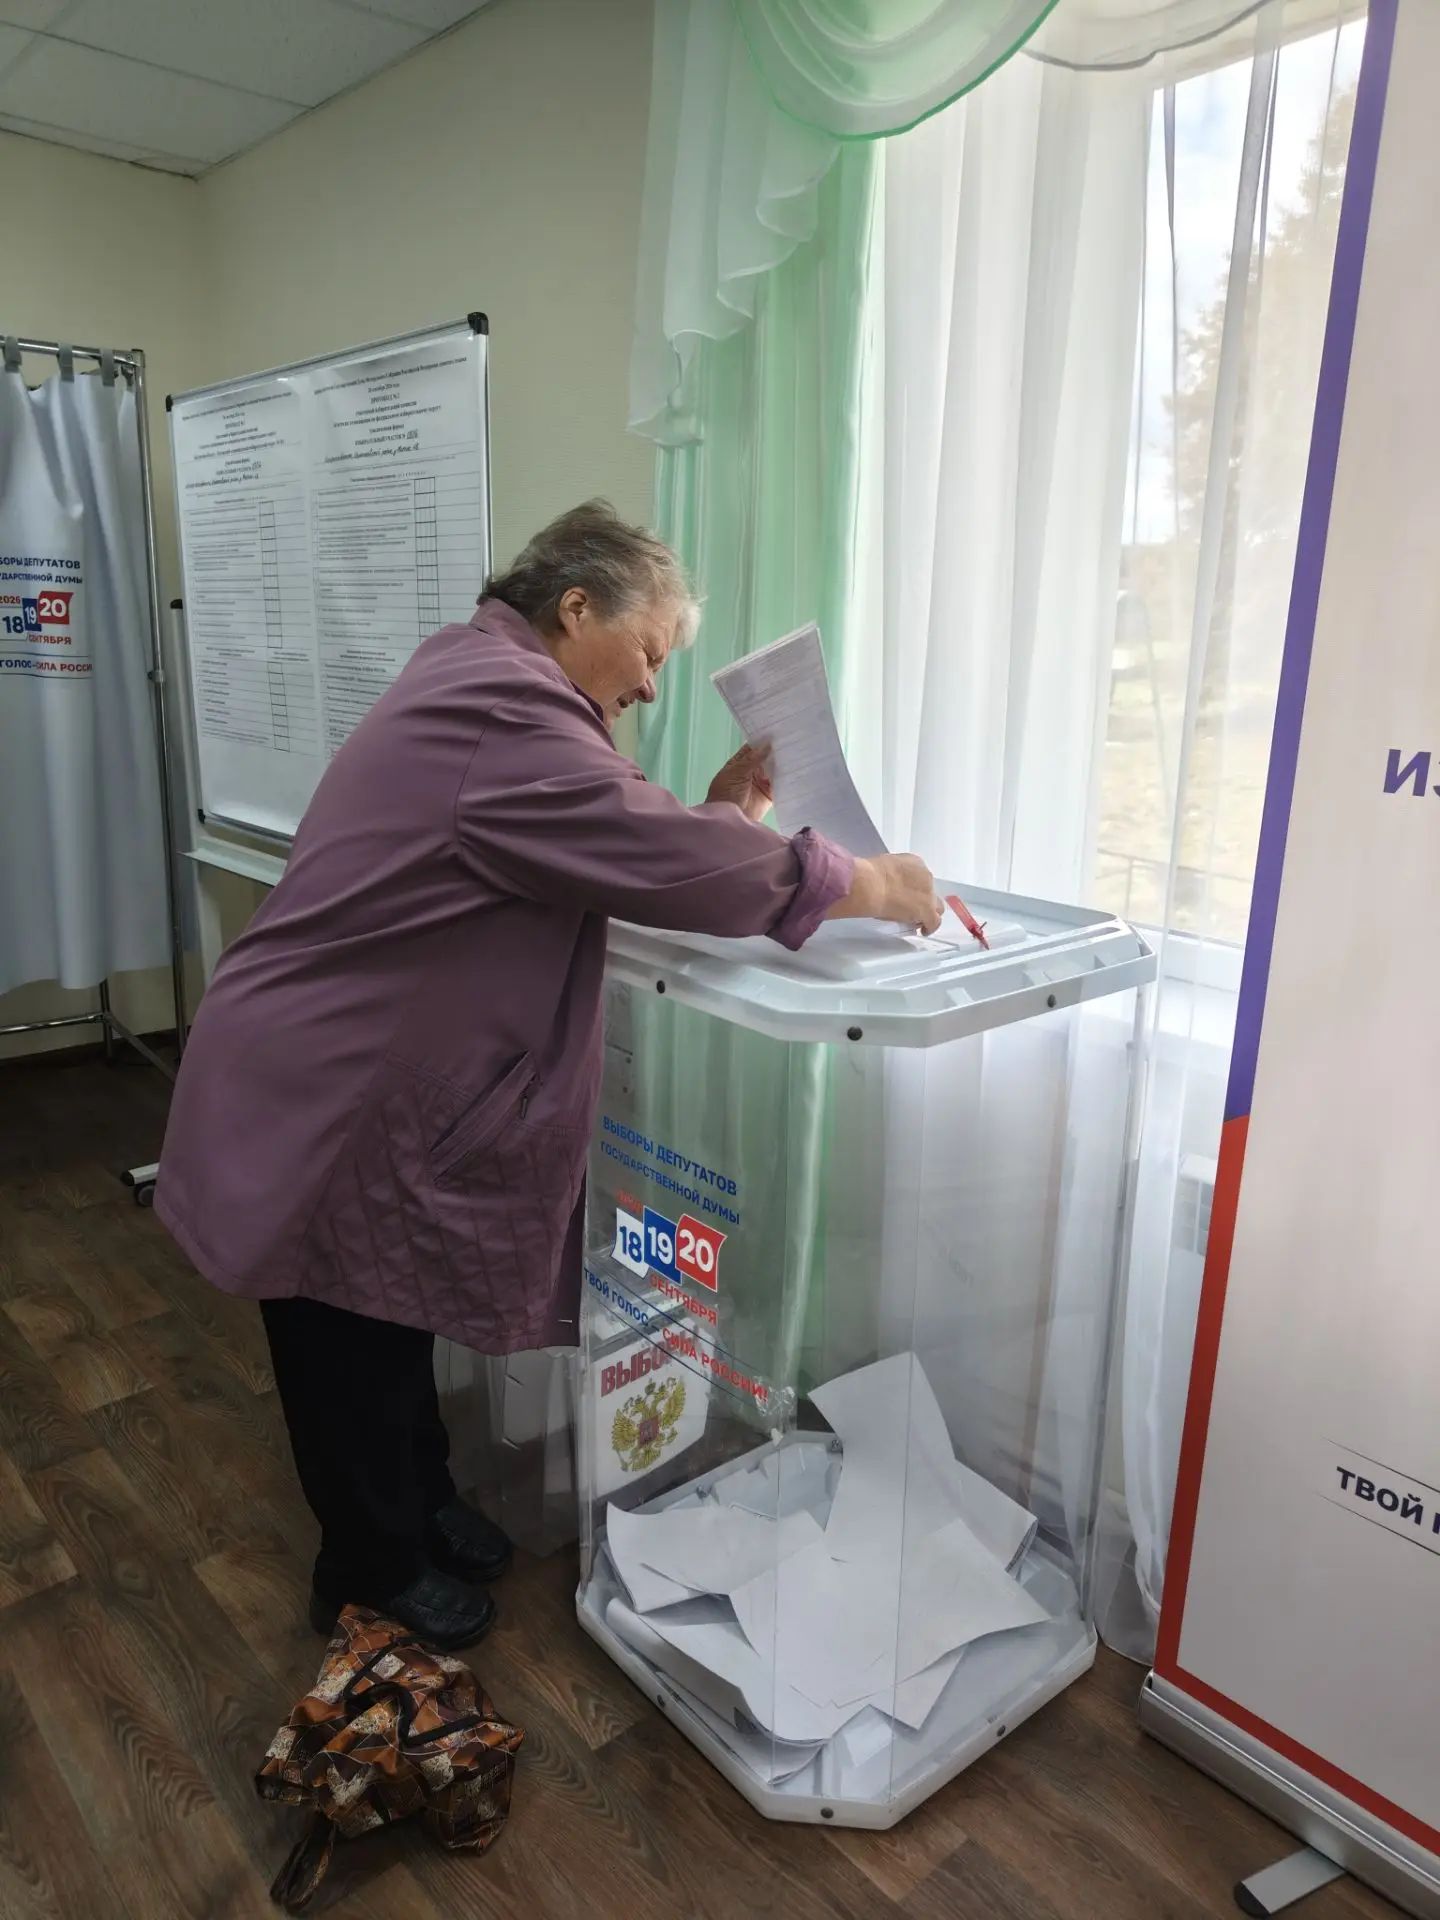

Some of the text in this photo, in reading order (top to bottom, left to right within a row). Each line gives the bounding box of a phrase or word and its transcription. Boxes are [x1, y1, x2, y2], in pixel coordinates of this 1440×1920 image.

[24, 558, 80, 569] ДЕПУТАТОВ
[55, 575, 83, 584] ДУМЫ
[2, 598, 67, 633] 18 19 20
[1383, 748, 1440, 800] И
[603, 1115, 738, 1197] ВЫБОРЫ ДЕПУТАТОВ
[601, 1140, 700, 1206] ГОСУДАРСТВЕННОЙ
[702, 1196, 740, 1225] ДУМЫ
[619, 1225, 715, 1273] 18 19 20
[584, 1267, 610, 1298] ТВОЙ
[612, 1295, 649, 1326] ГОЛОС
[651, 1274, 717, 1326] СЕНТЯБРЯ
[1336, 1465, 1424, 1526] ТВОЙ
